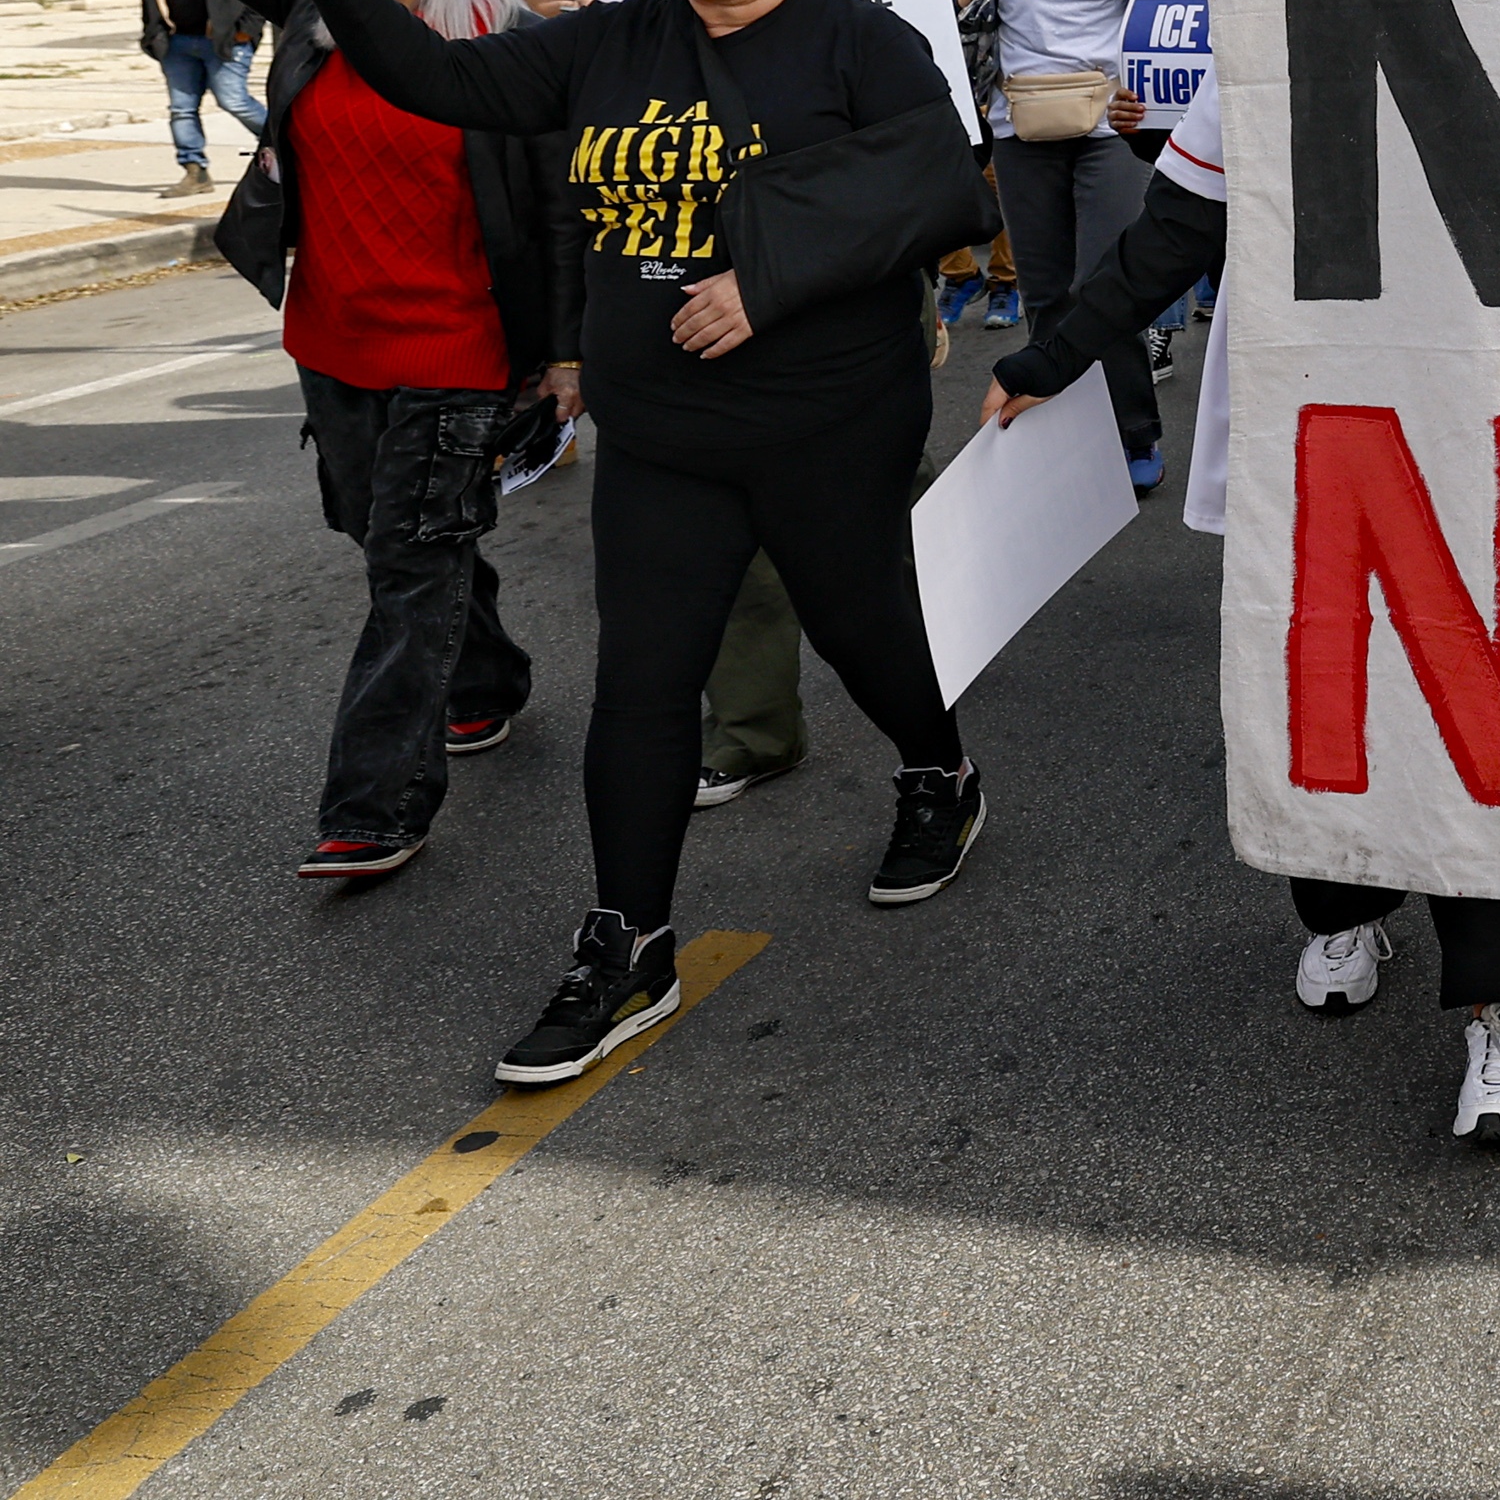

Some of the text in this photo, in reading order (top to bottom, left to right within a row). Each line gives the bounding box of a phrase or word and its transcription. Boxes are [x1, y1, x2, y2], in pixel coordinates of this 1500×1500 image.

[1149, 4, 1204, 49] ICE
[638, 99, 709, 124] LA
[580, 200, 715, 258] PEL
